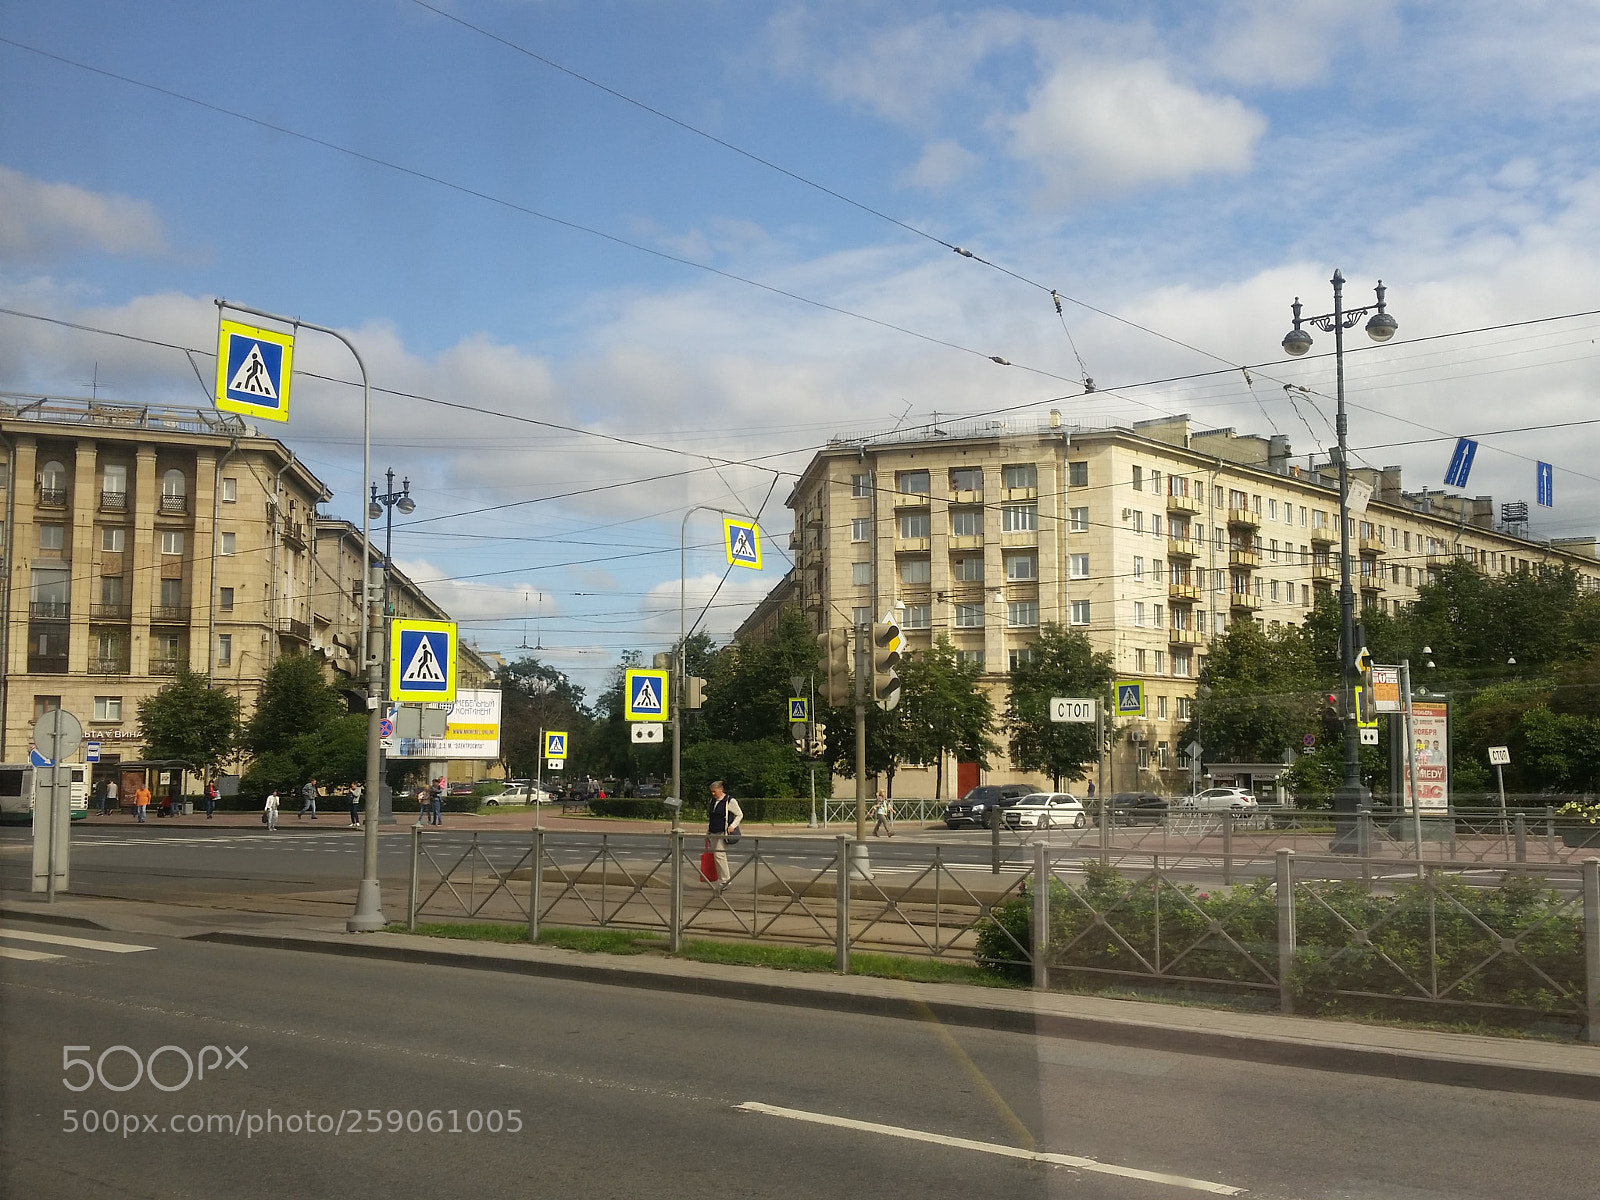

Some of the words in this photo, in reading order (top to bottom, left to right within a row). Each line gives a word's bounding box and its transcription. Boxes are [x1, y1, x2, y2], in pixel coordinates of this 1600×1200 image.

[456, 699, 495, 708] МЕБЕЛЬНЫЙ
[456, 708, 492, 716] КОНТИНЕНТ
[1057, 702, 1090, 718] СТОП
[81, 730, 104, 738] ЬТА
[1492, 750, 1508, 761] СТОП
[1406, 769, 1444, 779] CMEDY
